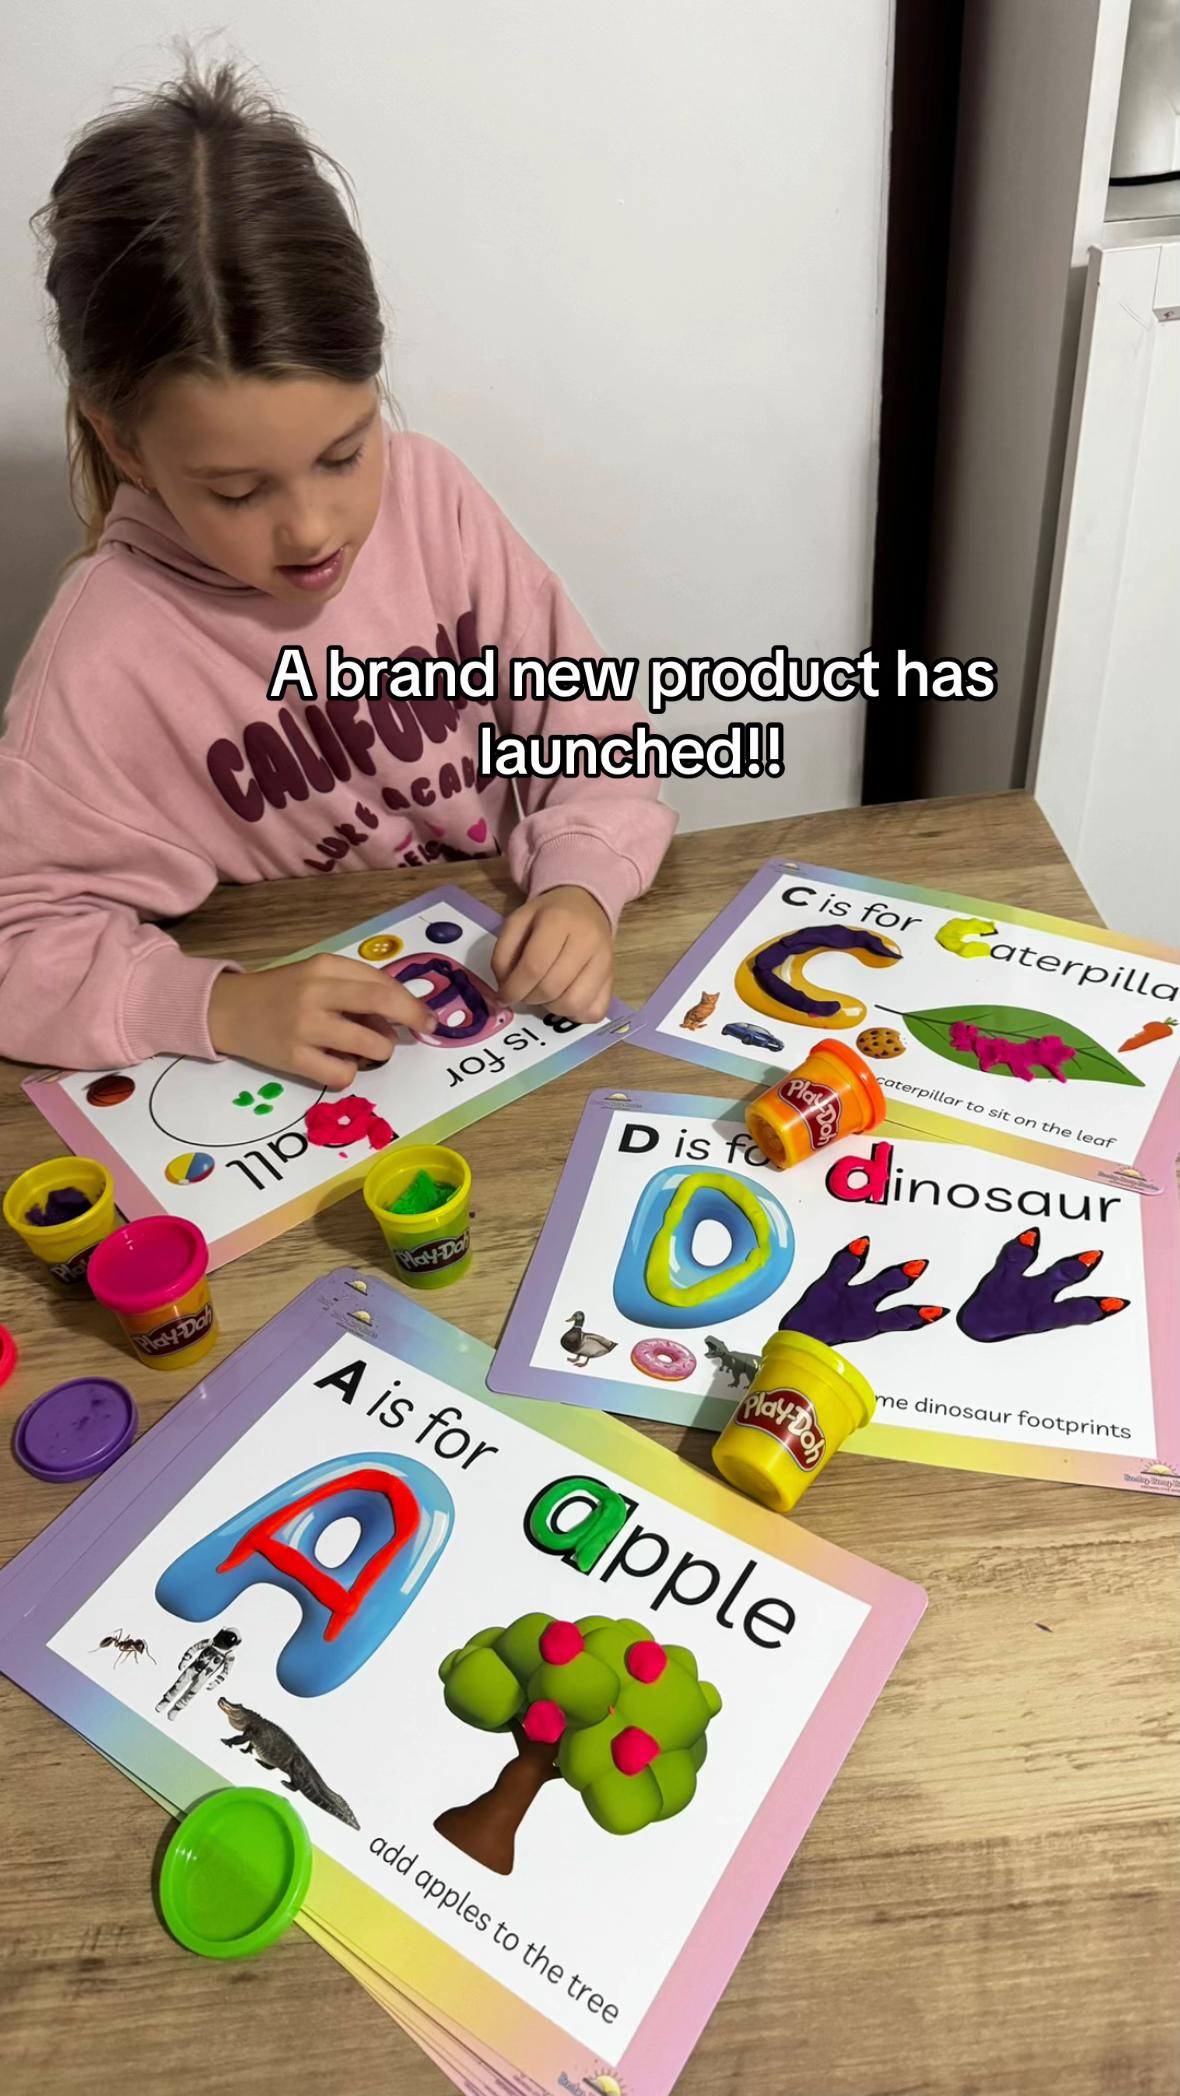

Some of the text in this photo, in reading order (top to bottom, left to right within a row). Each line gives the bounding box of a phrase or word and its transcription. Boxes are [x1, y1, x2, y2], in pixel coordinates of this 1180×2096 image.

[781, 886, 817, 907] C
[819, 893, 852, 917] is
[860, 902, 923, 933] for
[446, 1048, 506, 1089] for
[503, 1028, 547, 1052] is
[786, 1079, 839, 1147] Play-Doh
[875, 1076, 1118, 1149] caterpillar to sit on the leaf
[618, 1123, 660, 1154] D
[675, 1128, 711, 1161] is
[724, 1133, 771, 1168] fo
[824, 1141, 1122, 1224] dinosaur
[396, 1230, 469, 1270] Play-Doh
[134, 1304, 213, 1353] Play-Doh
[743, 1391, 825, 1464] Play-Doh
[873, 1395, 1133, 1440] me dinosaur footprints
[313, 1359, 797, 1650] A is for apple
[368, 1836, 620, 2025] add apples to the tree
